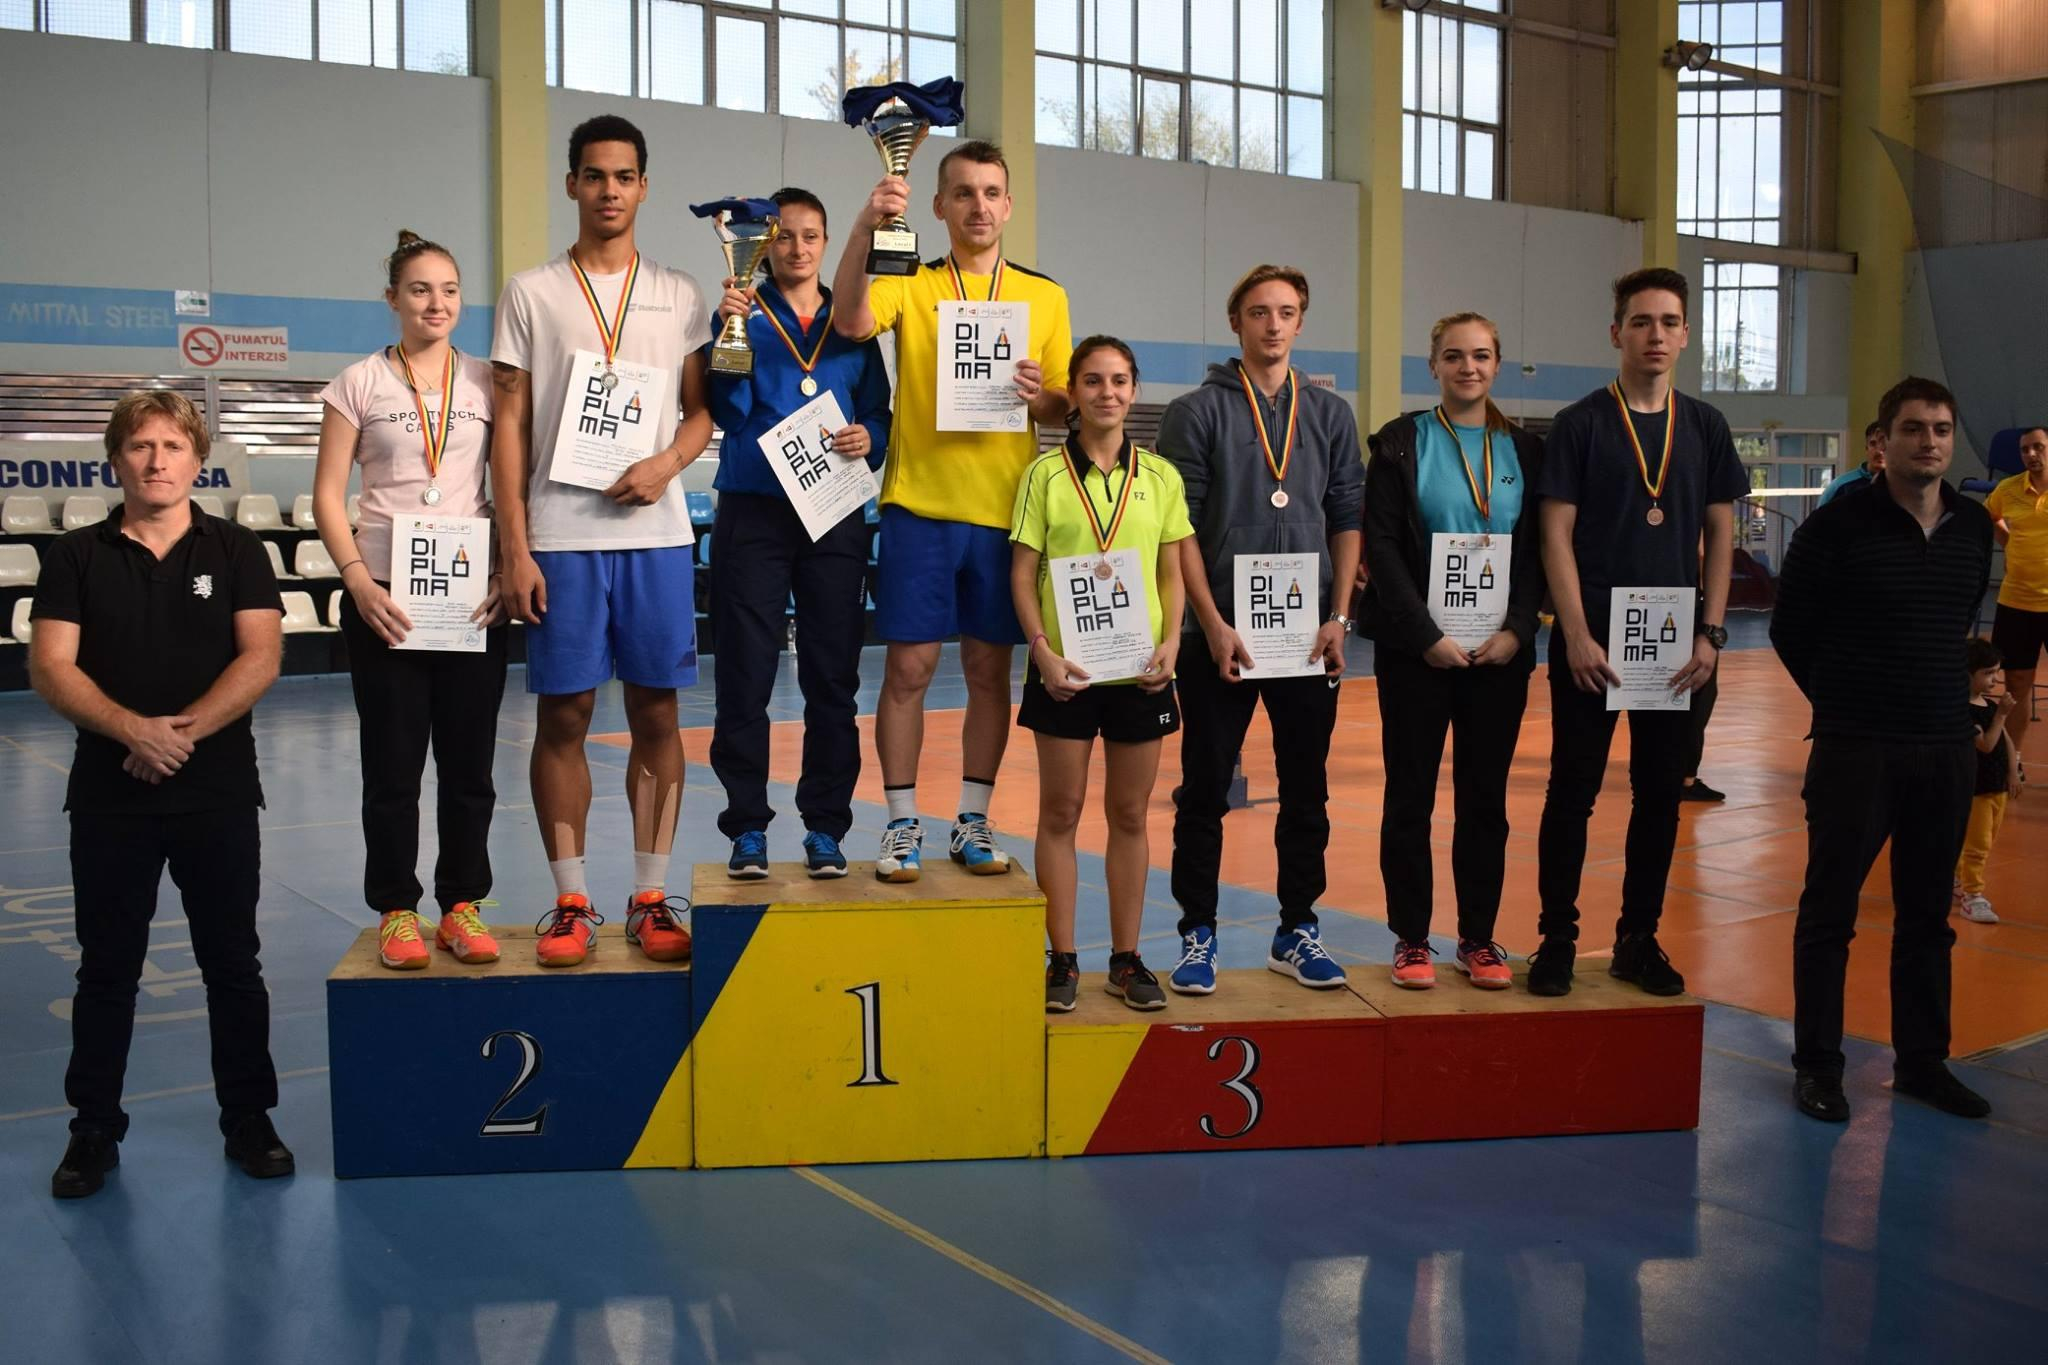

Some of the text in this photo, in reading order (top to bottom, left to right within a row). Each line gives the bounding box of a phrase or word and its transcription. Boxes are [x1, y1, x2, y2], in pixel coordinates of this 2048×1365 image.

[8, 302, 174, 329] MITTAL STEEL
[223, 334, 287, 345] FUMATUL
[955, 323, 979, 341] DI
[225, 351, 287, 362] INTERZIS
[955, 343, 1011, 360] PLO
[955, 362, 991, 379] MA
[1311, 379, 1334, 388] MATUL
[389, 410, 475, 423] SPOTOCH
[583, 395, 642, 425] PLO
[405, 421, 455, 433] CAS
[578, 415, 619, 439] MA
[781, 435, 806, 461] DI
[0, 459, 121, 488] CONFO
[798, 459, 831, 491] MA
[1134, 491, 1146, 501] FZ
[411, 538, 436, 556] DI
[410, 558, 470, 578] PLO
[1446, 554, 1467, 571] DI
[410, 578, 448, 596] MA
[1070, 576, 1095, 595] DI
[1250, 576, 1272, 592] DI
[1446, 573, 1494, 589] PLO
[1073, 591, 1130, 614] PLO
[1251, 593, 1302, 611] PLO
[1444, 592, 1477, 607] MA
[1076, 612, 1114, 633] MA
[1252, 612, 1285, 629] MA
[1626, 609, 1648, 625] DI
[1625, 627, 1676, 643] PLO
[1624, 645, 1657, 661] MA
[1160, 713, 1171, 724] FZ
[845, 982, 899, 1088] 1
[479, 1030, 548, 1138] 2
[1199, 1035, 1264, 1139] 3
